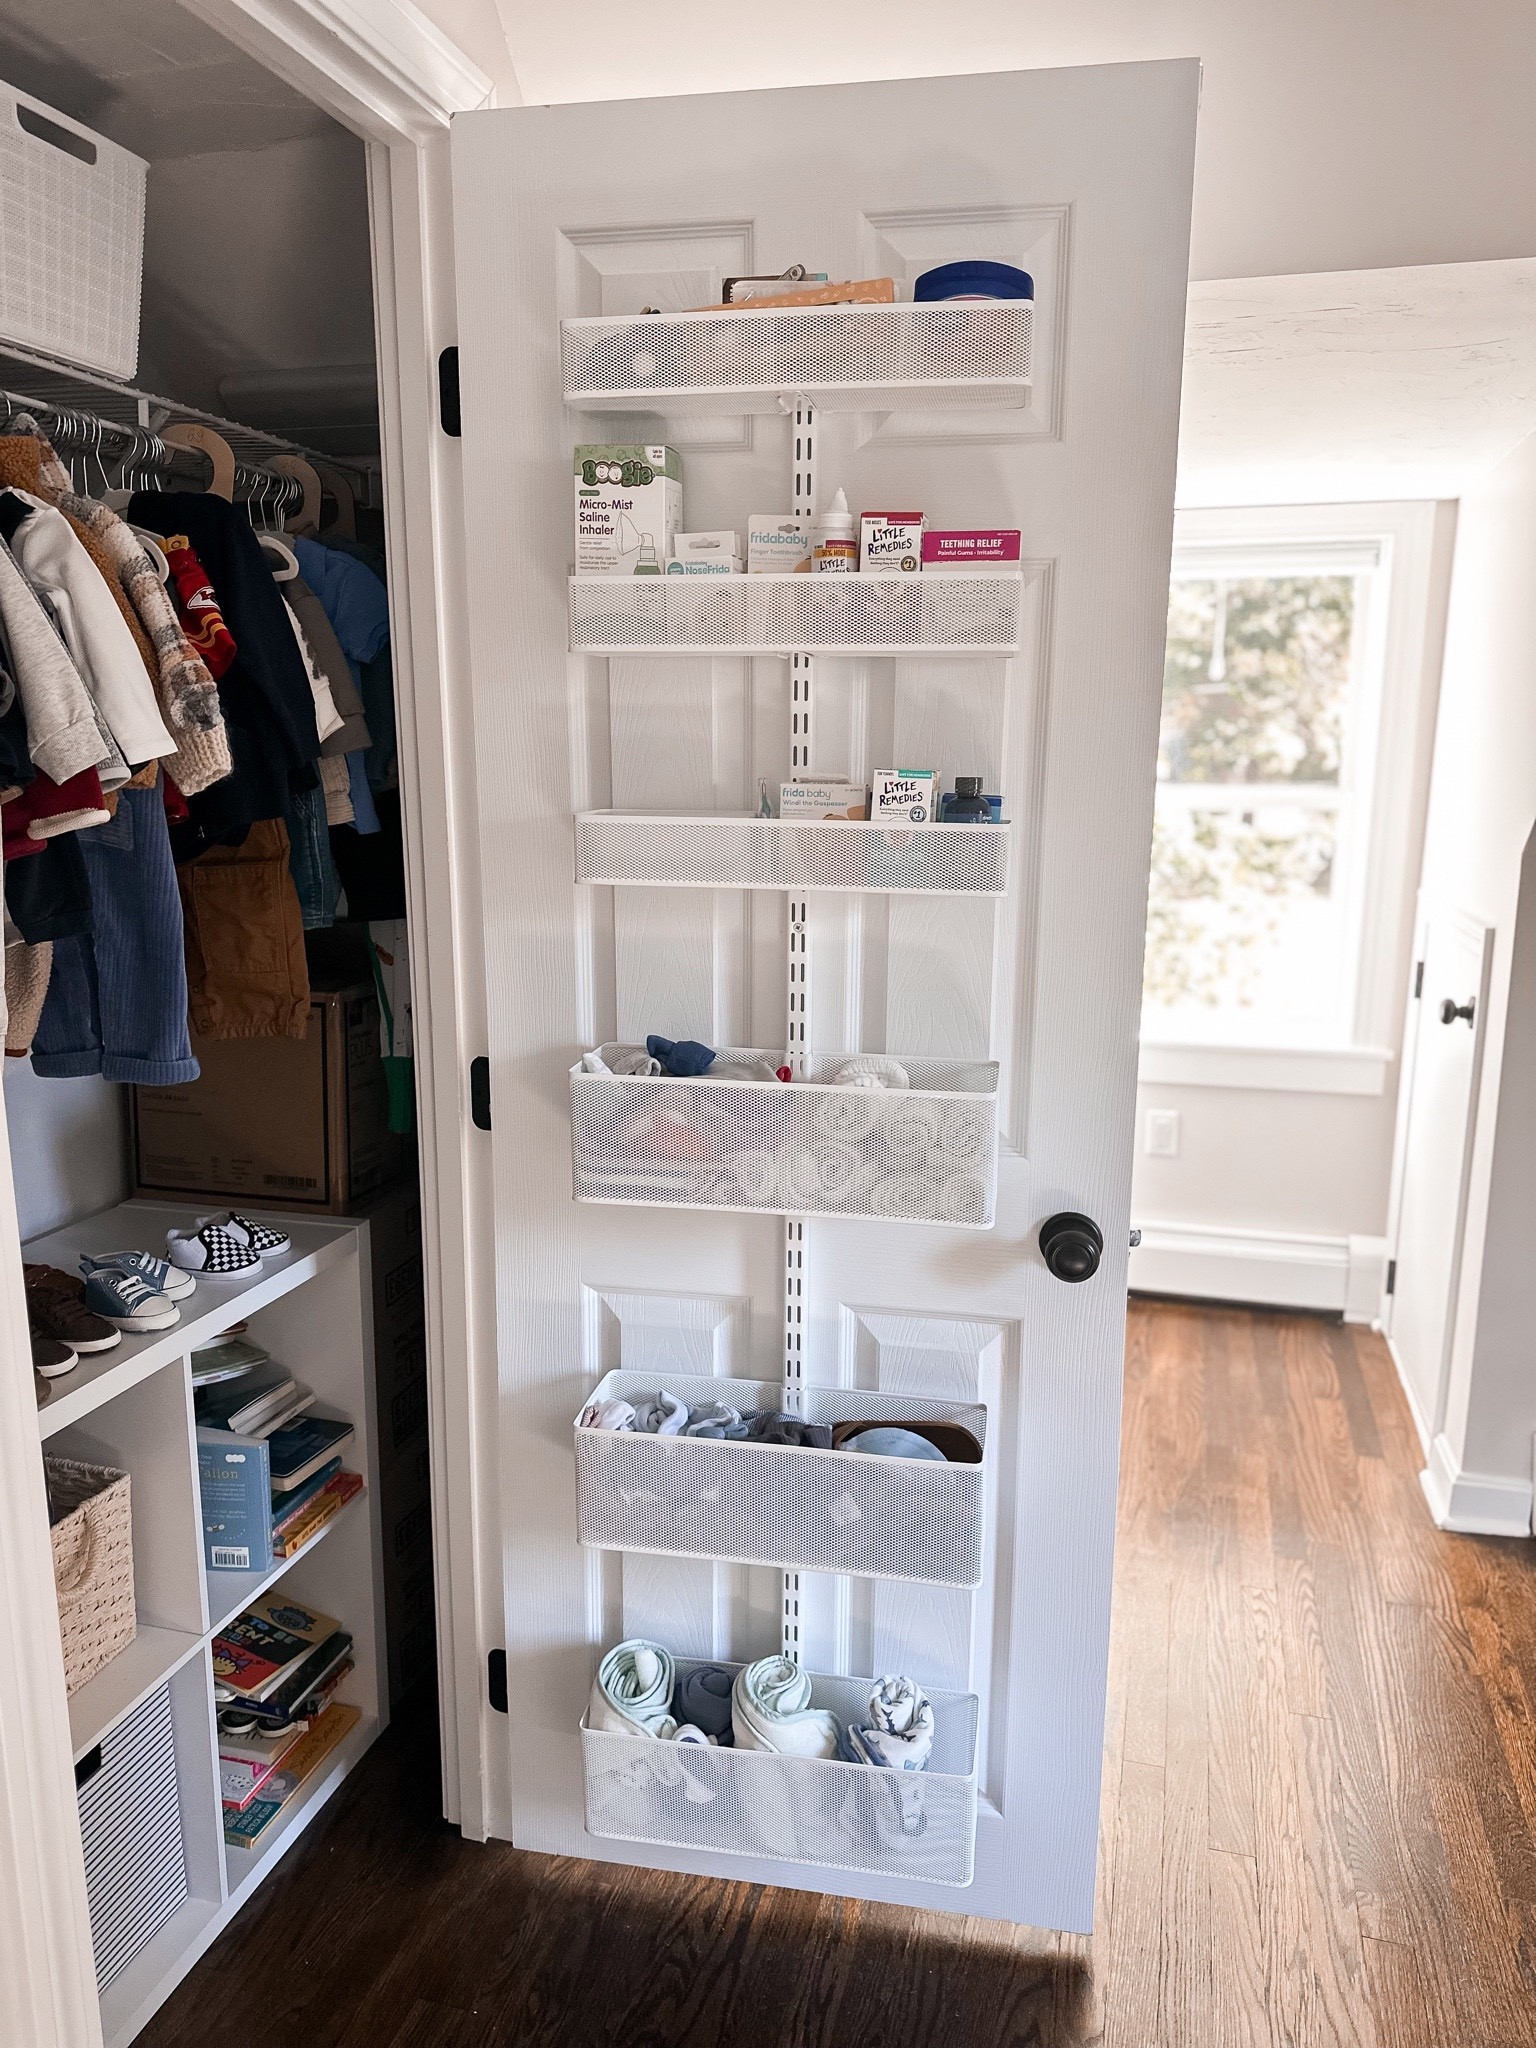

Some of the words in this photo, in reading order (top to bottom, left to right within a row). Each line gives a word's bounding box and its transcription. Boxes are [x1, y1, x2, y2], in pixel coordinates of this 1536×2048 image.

[582, 460, 654, 487] Boogie
[579, 499, 633, 510] Micro-Mist
[579, 512, 610, 522] Saline
[579, 525, 614, 535] Inhaler
[751, 532, 808, 548] fridababy
[940, 539, 975, 548] TEETHING
[977, 539, 1002, 548] RELIEF
[868, 538, 912, 556] REMEDIES
[686, 565, 730, 574] NoseFrida
[782, 788, 804, 797] frida
[807, 789, 831, 800] baby
[880, 792, 923, 806] REMEDIES
[200, 1466, 238, 1479] allon
[248, 1617, 269, 1630] TO
[273, 1630, 298, 1644] BE
